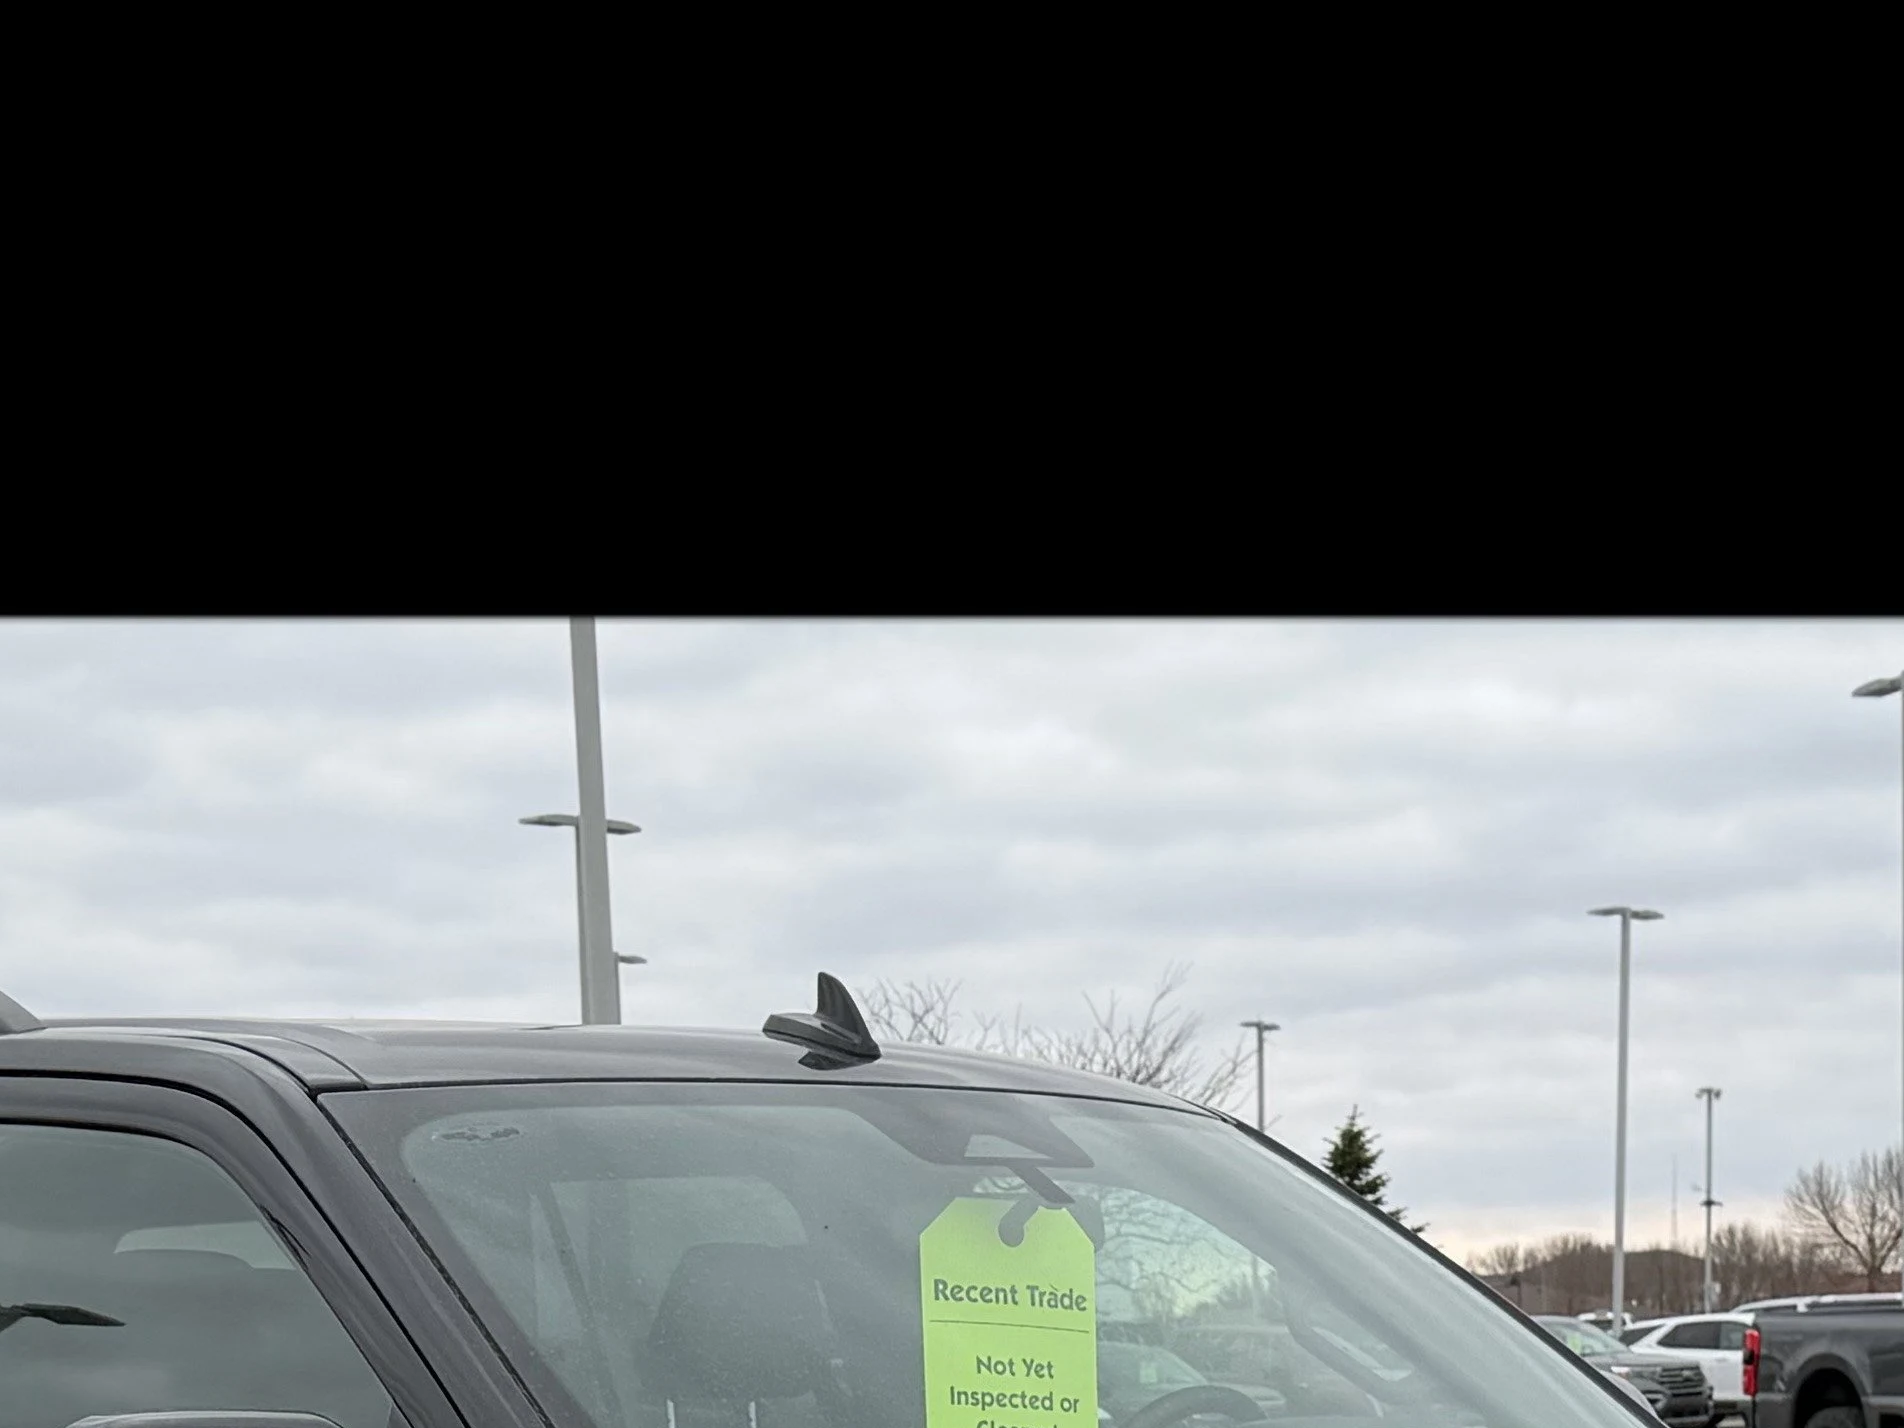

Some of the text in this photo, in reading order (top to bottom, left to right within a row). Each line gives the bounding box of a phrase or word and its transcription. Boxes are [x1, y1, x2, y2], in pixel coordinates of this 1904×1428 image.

[933, 1278, 1088, 1312] Recent Trade
[976, 1355, 1055, 1380] Not Yet
[950, 1385, 1080, 1413] Inspected or
